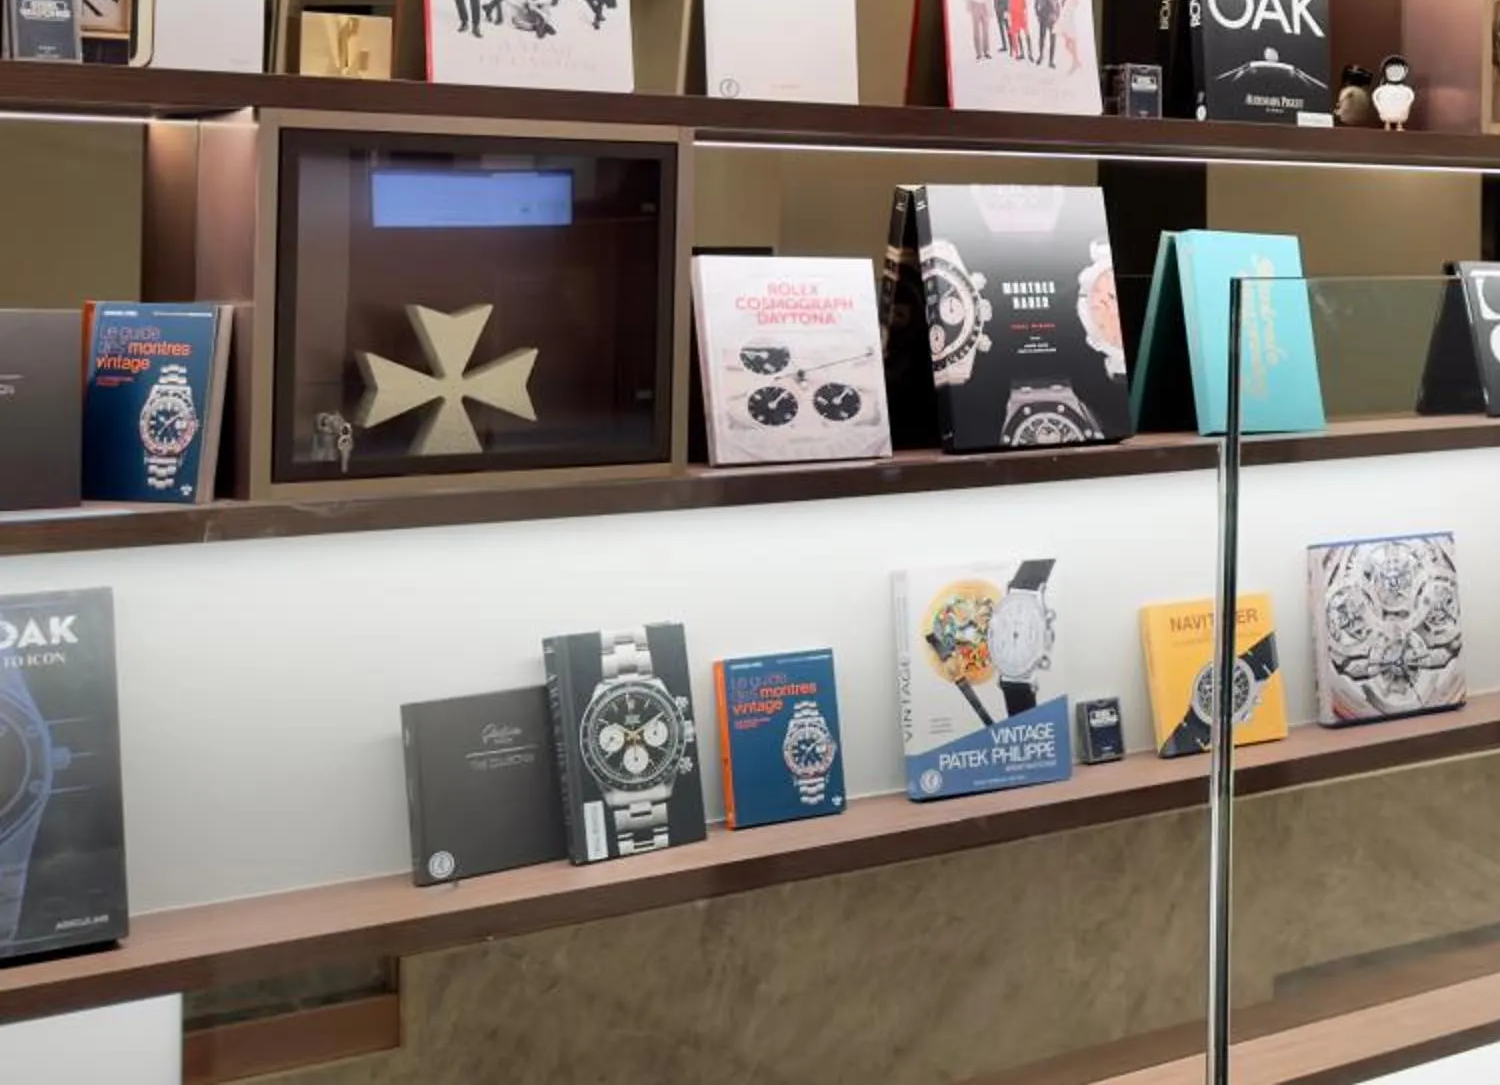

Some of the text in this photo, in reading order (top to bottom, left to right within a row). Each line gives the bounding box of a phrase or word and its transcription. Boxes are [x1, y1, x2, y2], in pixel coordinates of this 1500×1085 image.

[736, 296, 854, 311] COSMOGRAPH
[757, 311, 838, 326] DAYTONA
[127, 340, 192, 356] montres
[96, 354, 151, 373] vintage
[1170, 607, 1260, 632] NAVITER
[991, 721, 1056, 745] VINTAGE
[938, 748, 989, 772] PATEK
[991, 739, 1056, 765] PHILIPPE
